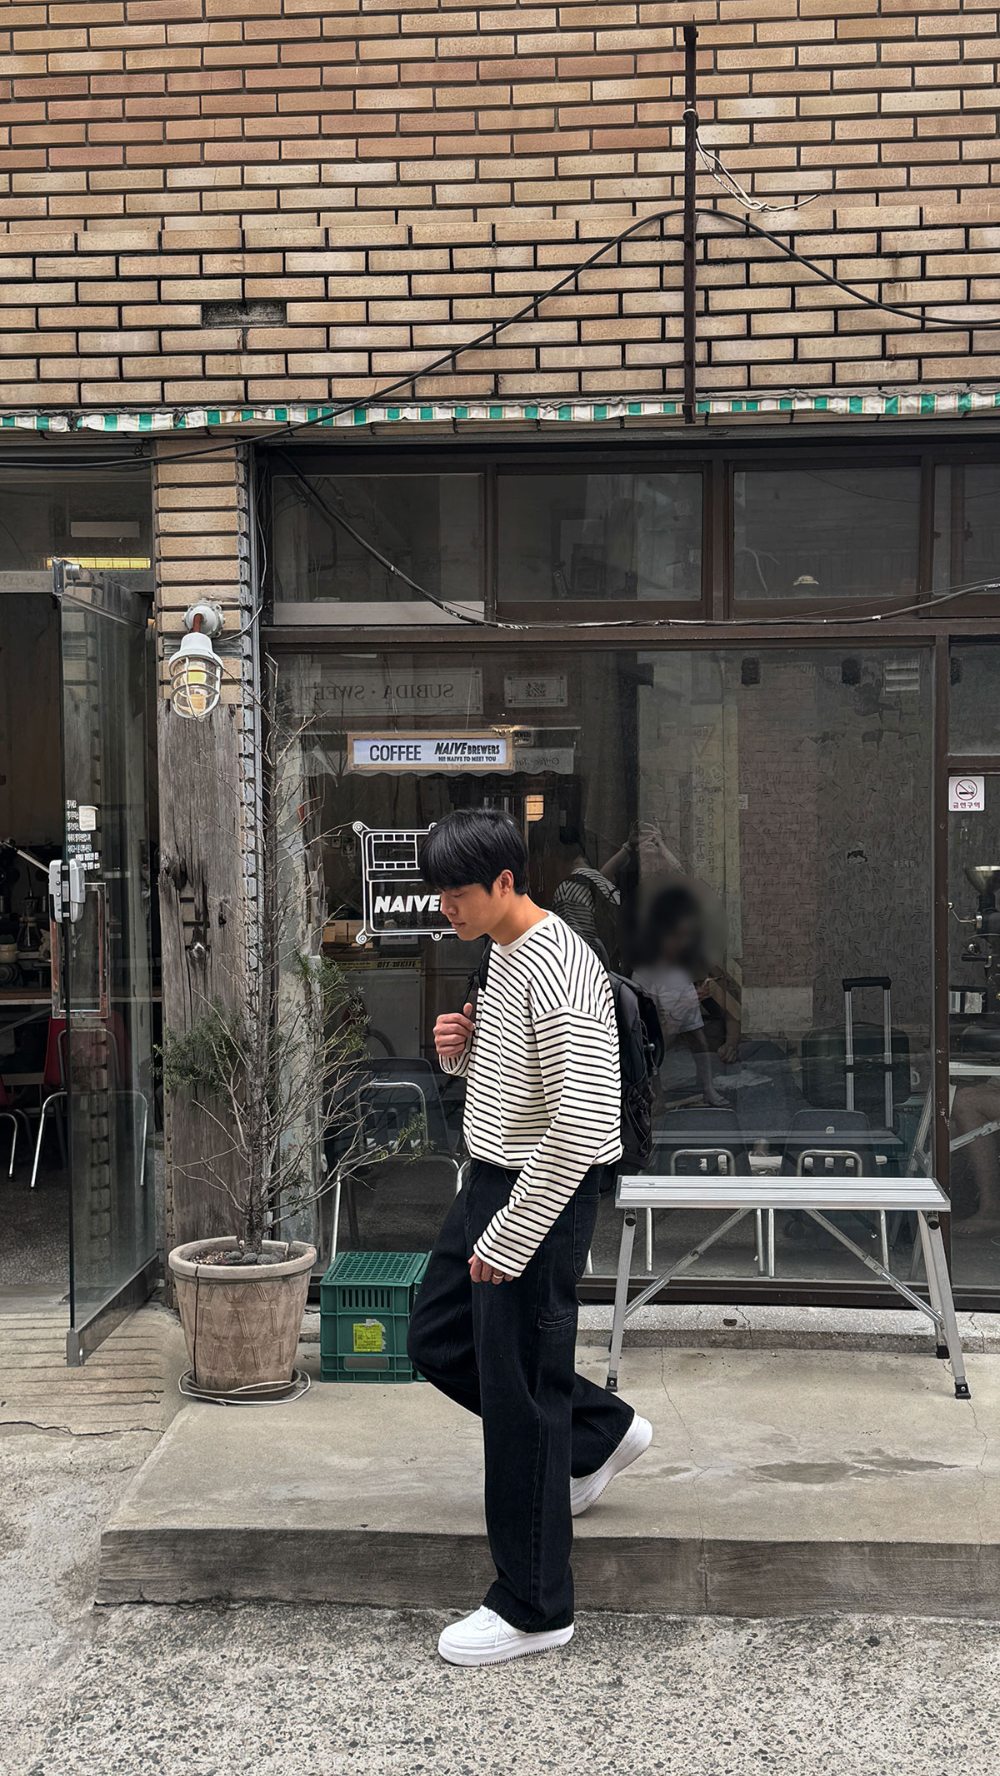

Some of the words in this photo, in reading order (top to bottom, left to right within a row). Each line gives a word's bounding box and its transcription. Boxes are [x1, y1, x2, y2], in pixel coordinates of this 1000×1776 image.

[369, 744, 422, 761] COFFEE
[434, 742, 468, 755] NAIVE
[467, 744, 500, 755] BREWERS
[953, 801, 981, 809] 금연구역
